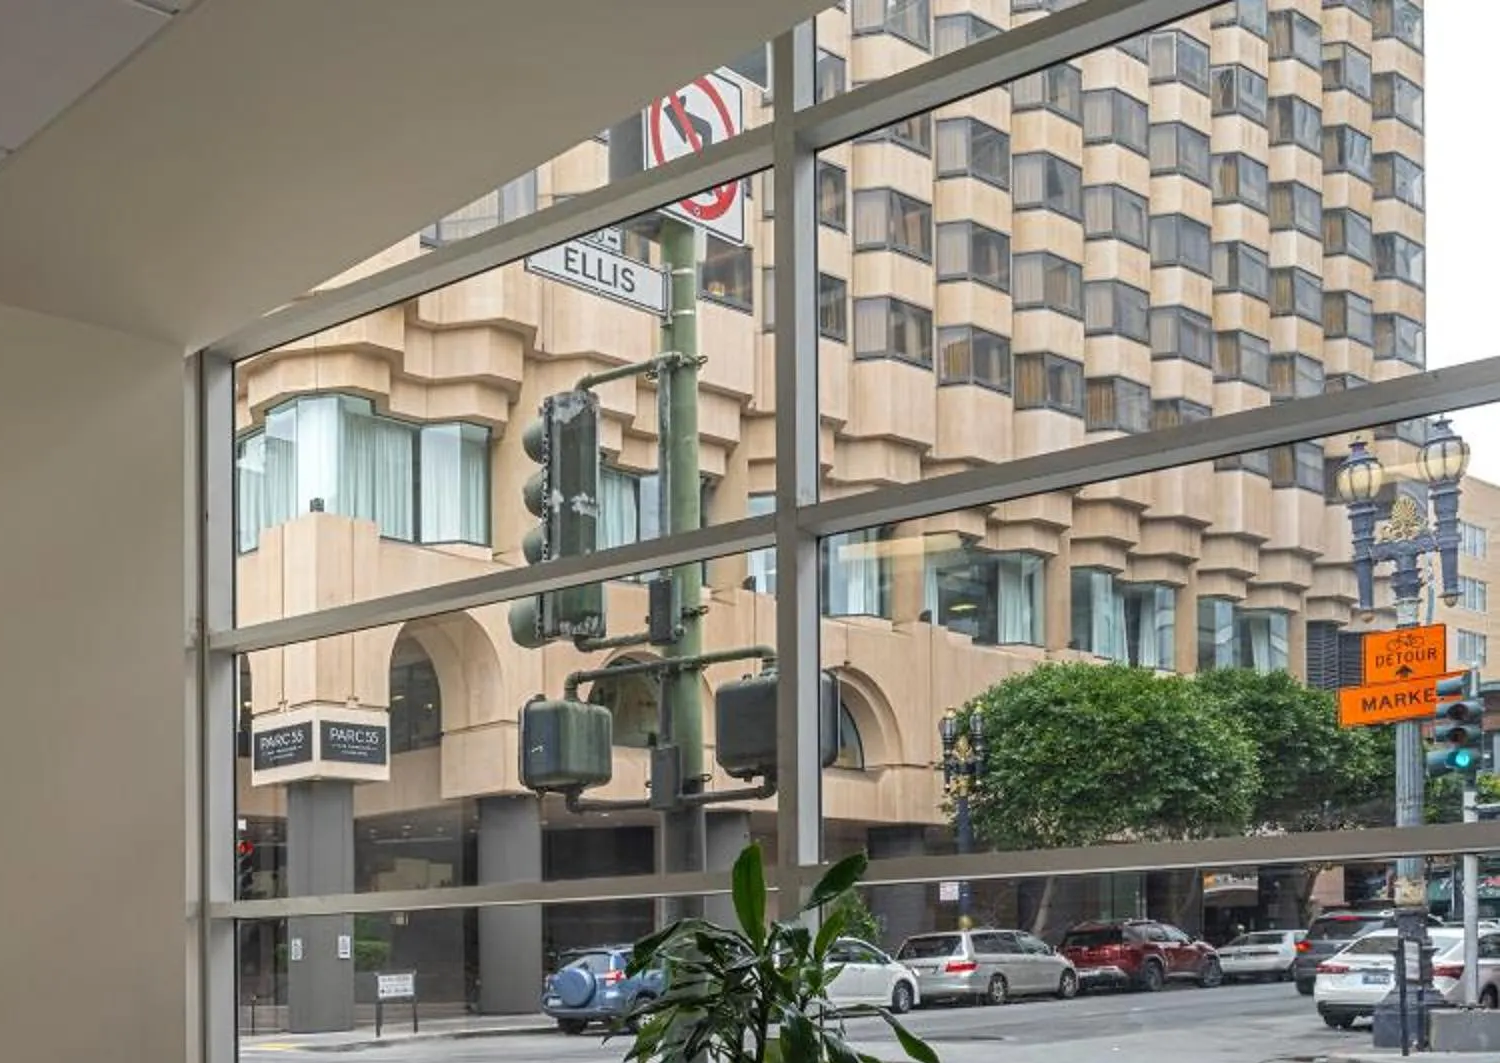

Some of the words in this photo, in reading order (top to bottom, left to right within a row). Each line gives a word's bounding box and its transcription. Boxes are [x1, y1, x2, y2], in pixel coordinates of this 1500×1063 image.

[563, 246, 636, 294] ELLIS
[1375, 647, 1438, 669] DETOUR
[1361, 687, 1445, 713] MARKE
[328, 727, 365, 743] PARC
